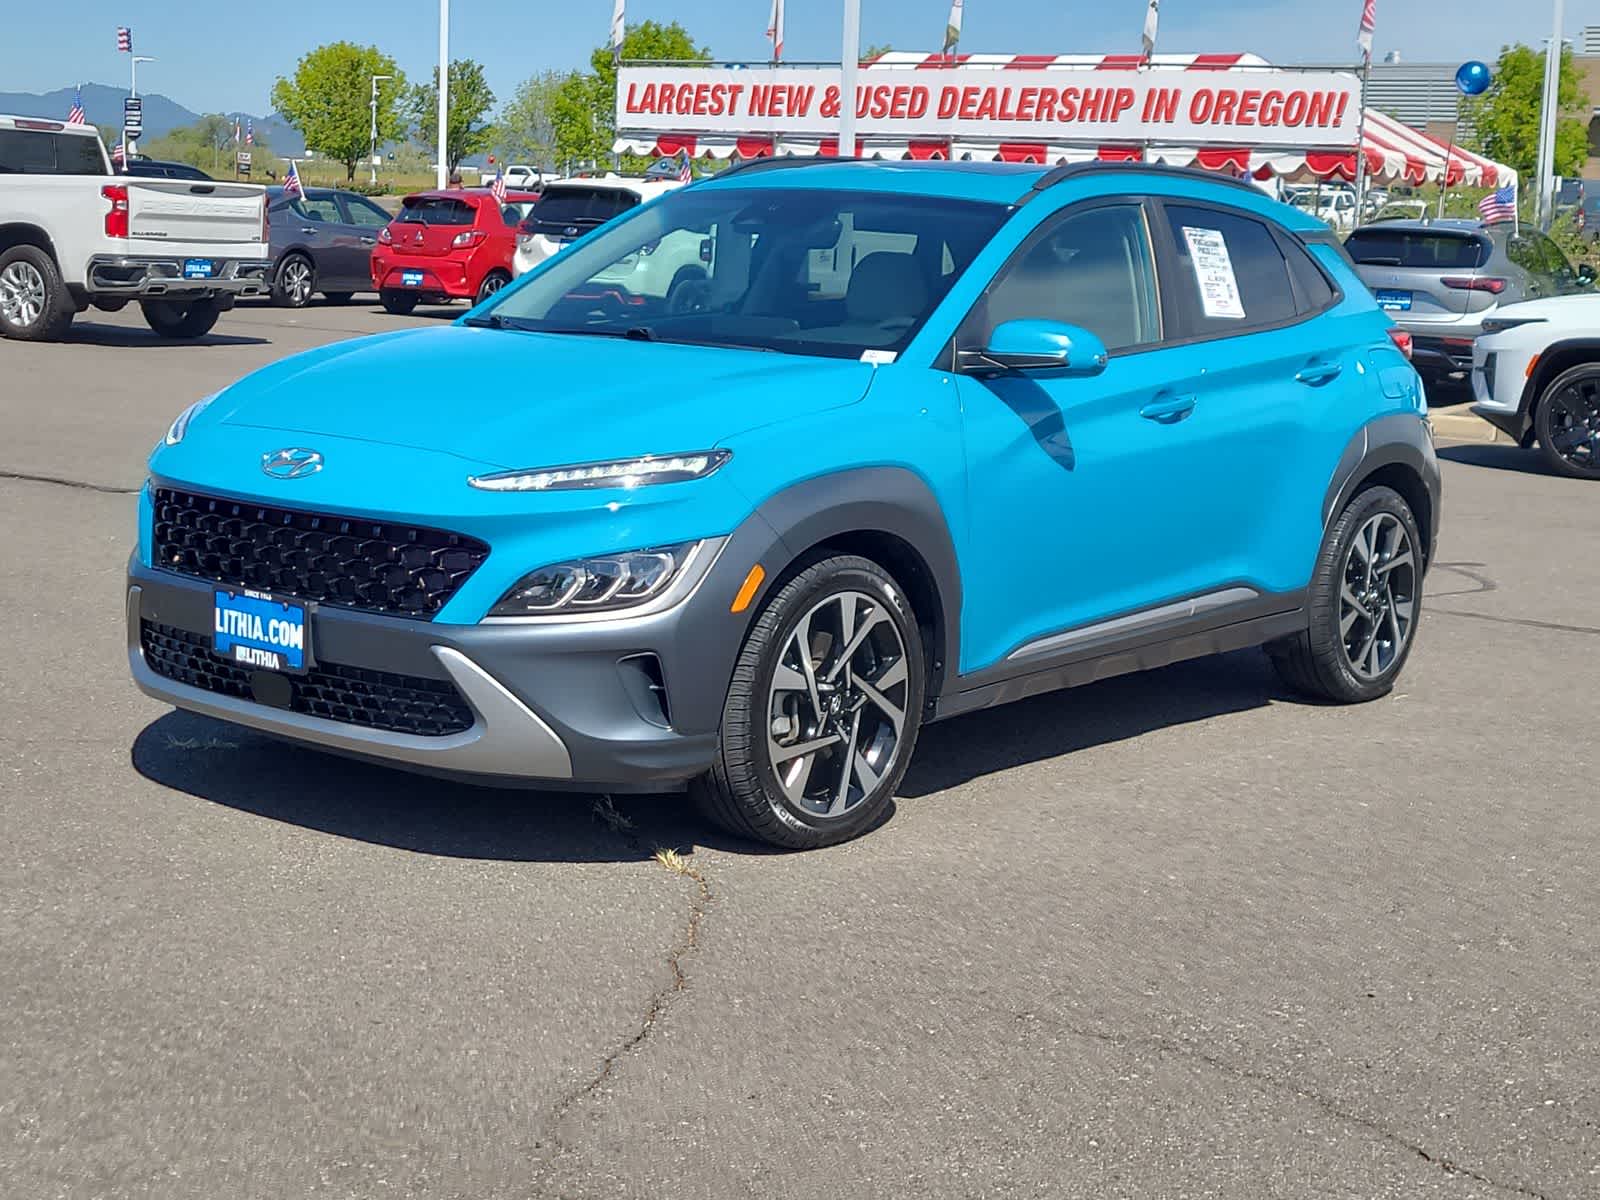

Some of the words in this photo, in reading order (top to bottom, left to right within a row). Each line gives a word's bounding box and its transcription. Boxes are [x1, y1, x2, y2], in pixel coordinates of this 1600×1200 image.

[625, 83, 744, 116] LARGEST
[749, 84, 815, 117] NEW
[819, 85, 841, 118] &
[855, 85, 931, 119] USED
[937, 86, 1136, 122] DEALERSHIP
[1141, 88, 1182, 123] IN
[1189, 88, 1350, 128] OREGON!
[215, 607, 304, 650] LITHIA.COM
[246, 647, 280, 670] LITHIA
